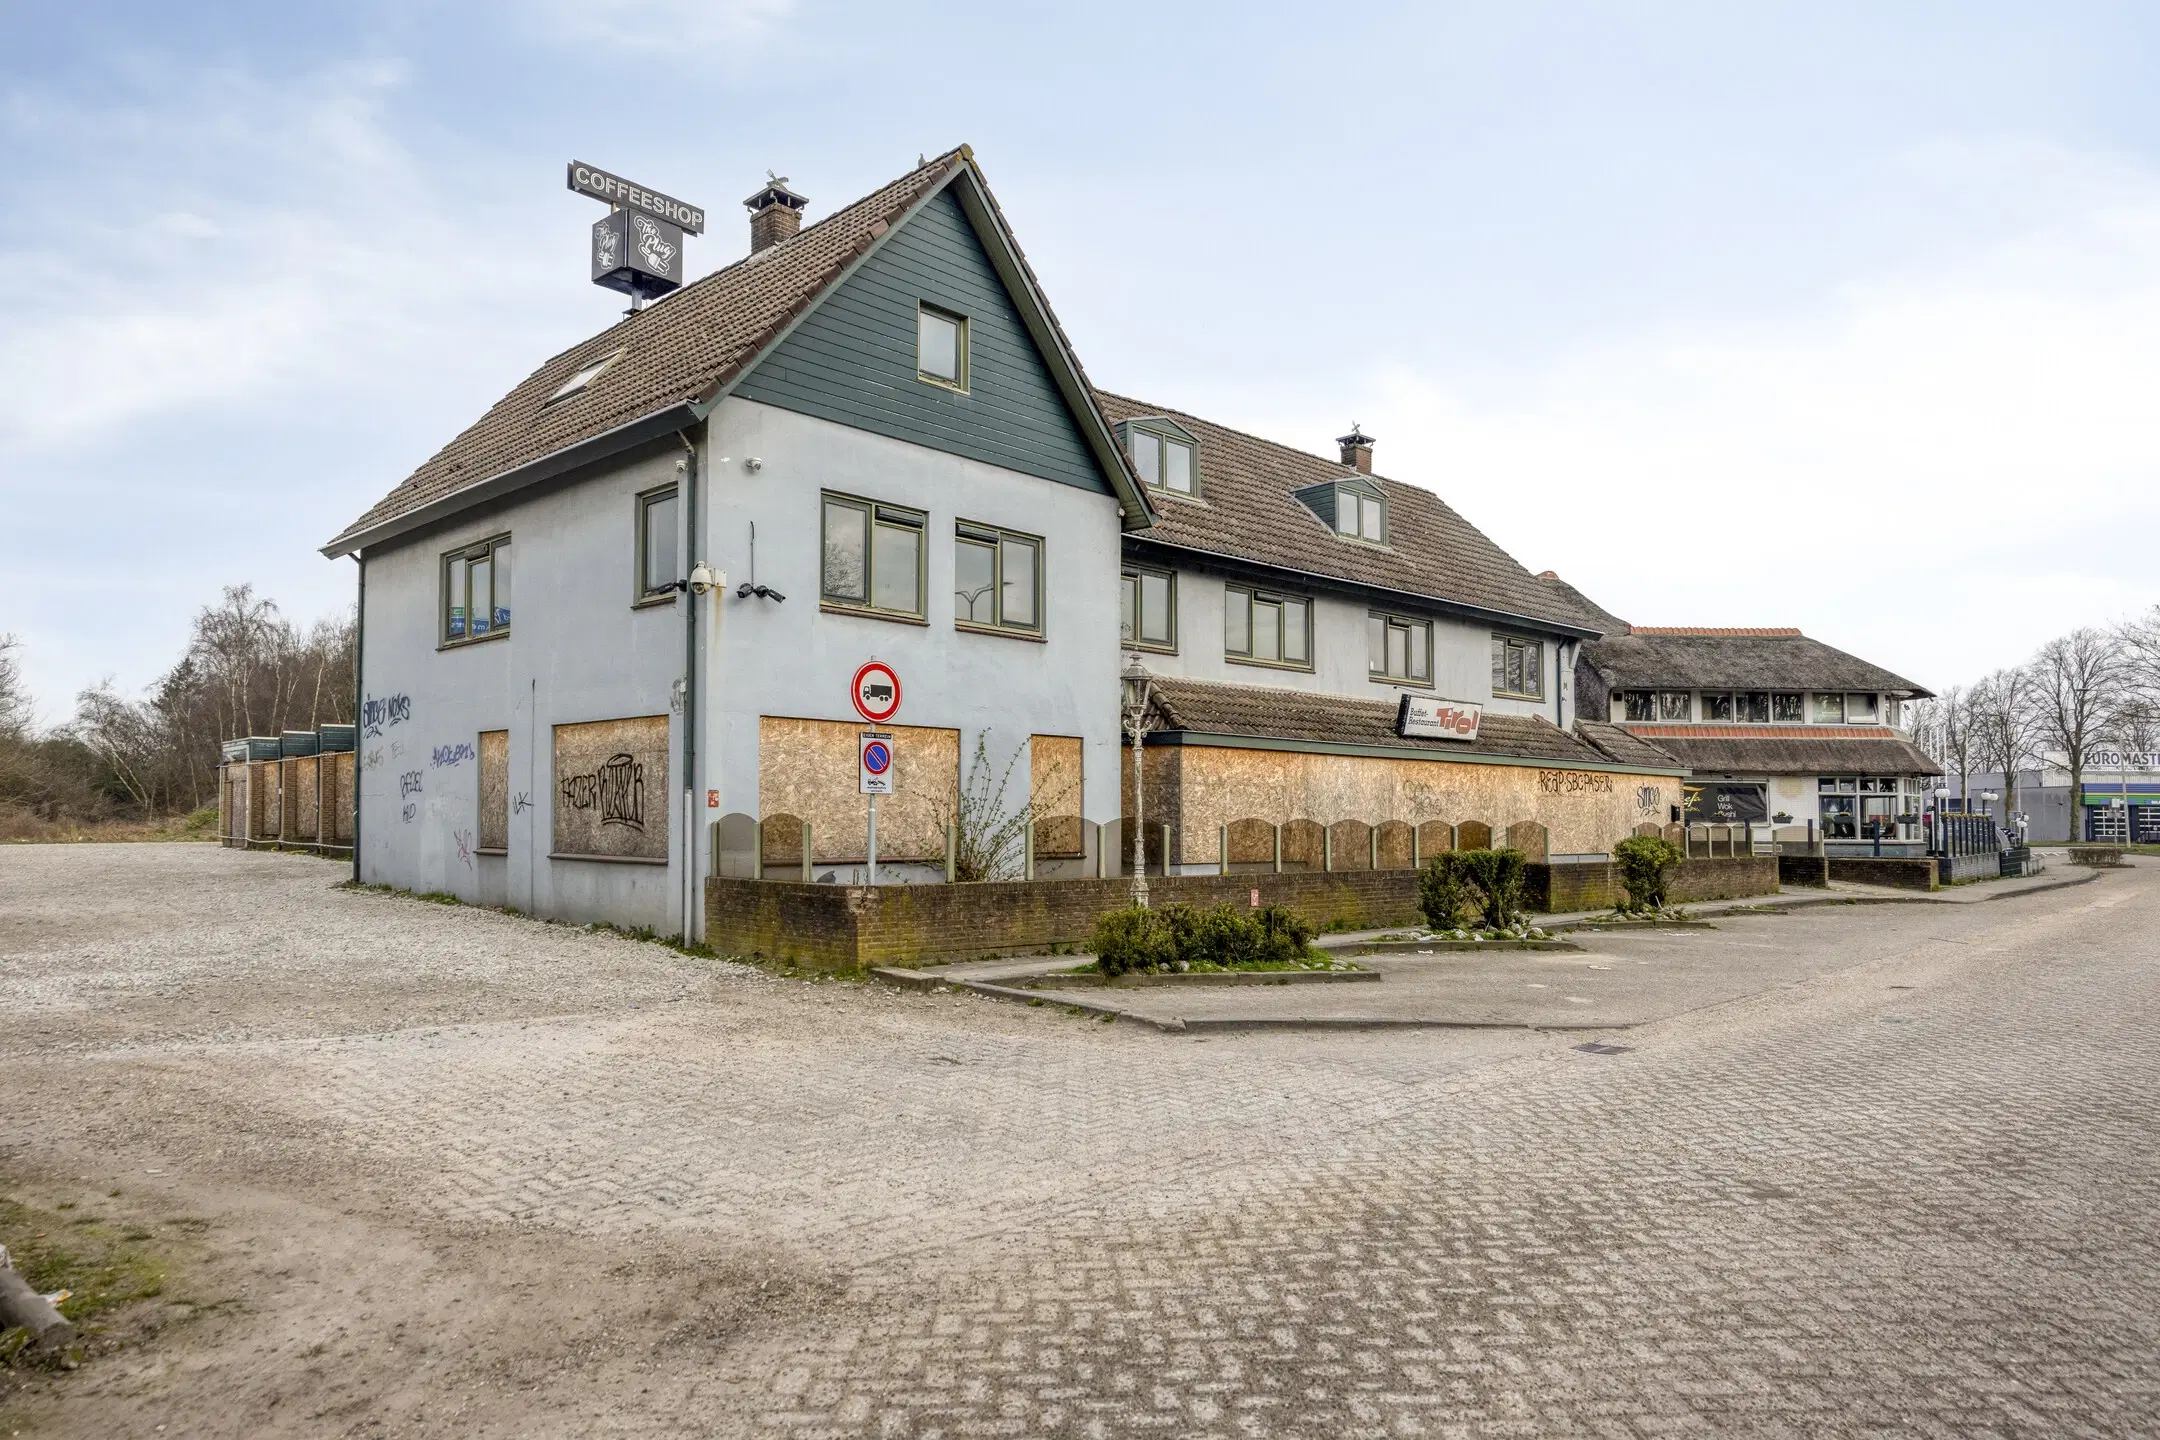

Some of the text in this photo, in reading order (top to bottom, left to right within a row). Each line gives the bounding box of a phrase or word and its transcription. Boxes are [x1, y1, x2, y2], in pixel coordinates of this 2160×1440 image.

[575, 167, 703, 227] COFFEESHOP
[637, 219, 657, 235] The
[642, 233, 674, 259] Plug
[1408, 717, 1439, 728] Restaurant
[1436, 707, 1479, 735] Tirol
[1717, 794, 1731, 803] Grill
[1717, 802, 1734, 810] Wok
